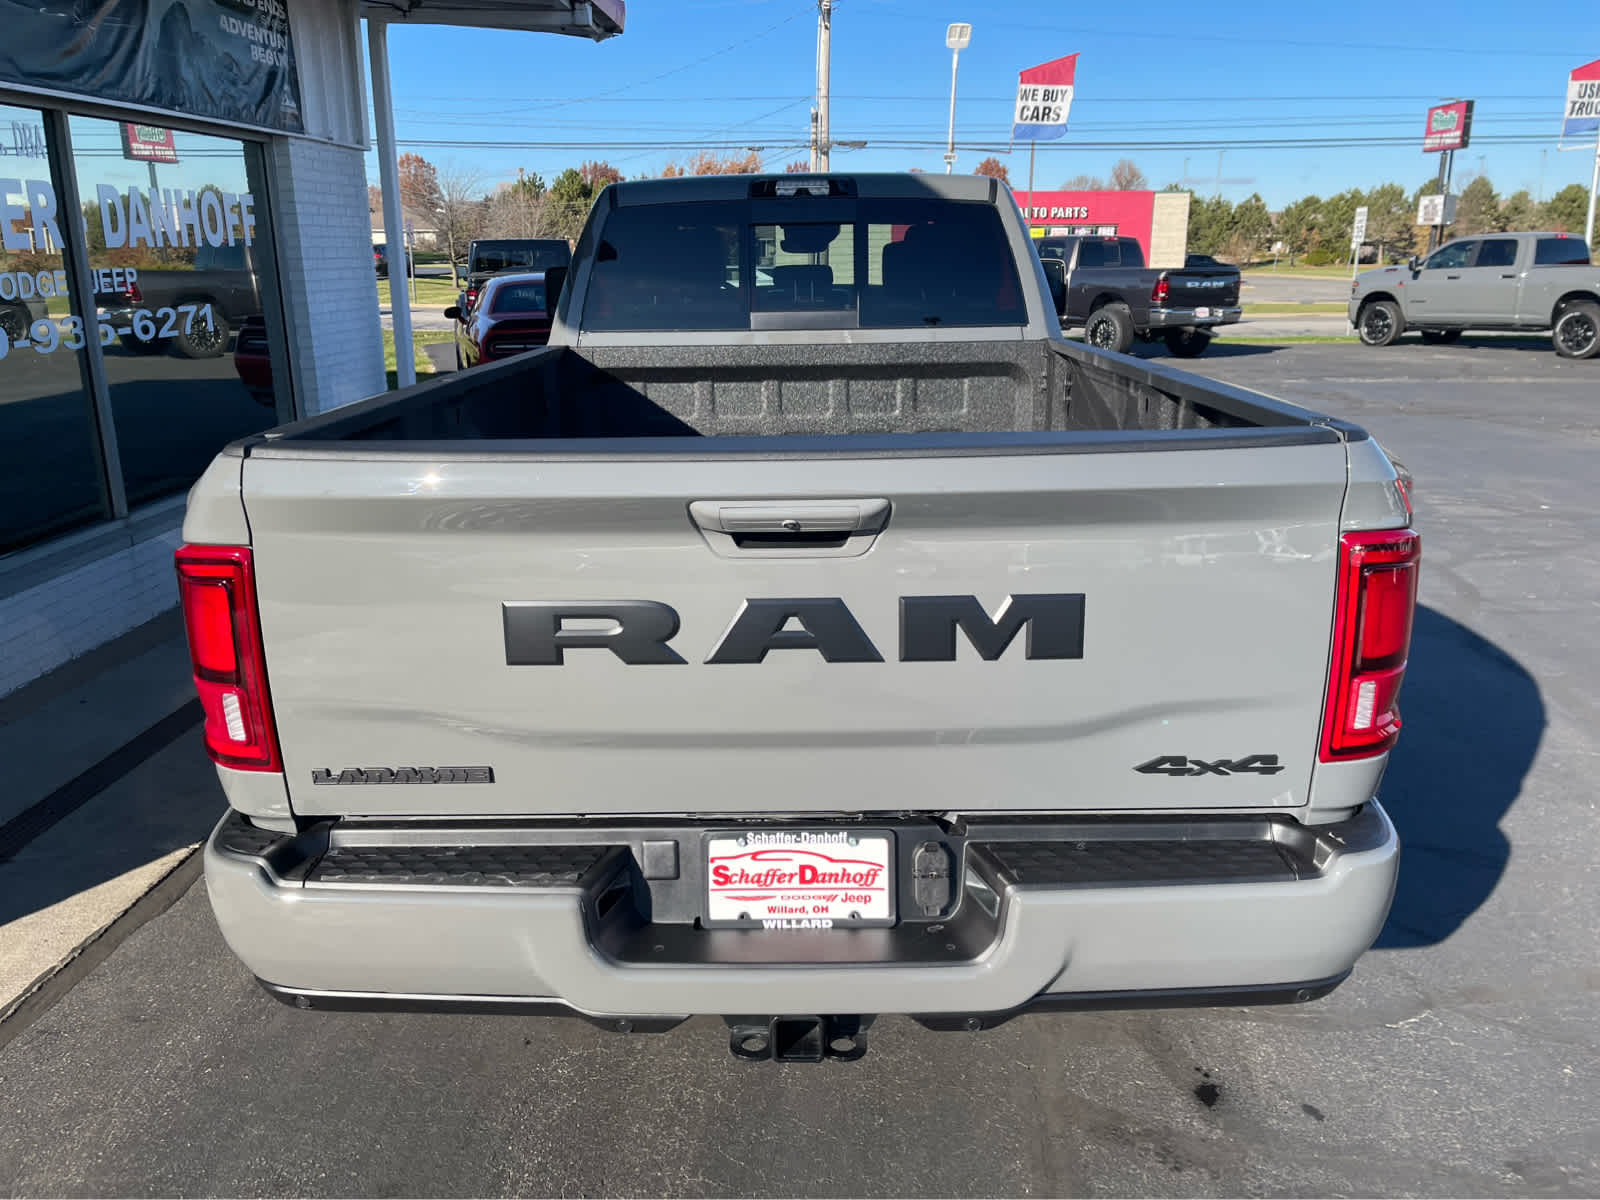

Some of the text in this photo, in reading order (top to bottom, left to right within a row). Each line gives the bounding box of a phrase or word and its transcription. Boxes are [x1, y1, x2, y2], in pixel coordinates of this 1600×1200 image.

[1020, 88, 1068, 102] WE BUY
[1020, 105, 1063, 122] CARS
[96, 183, 256, 249] DANHOFF
[1051, 206, 1088, 219] PARTS
[0, 267, 137, 300] ODGE JEEP
[502, 593, 1086, 666] RAM
[746, 832, 848, 846] Schaffer-Danhoff
[841, 892, 872, 905] Jeep
[767, 905, 829, 915] Willard, OH
[762, 919, 833, 929] WILLARD
